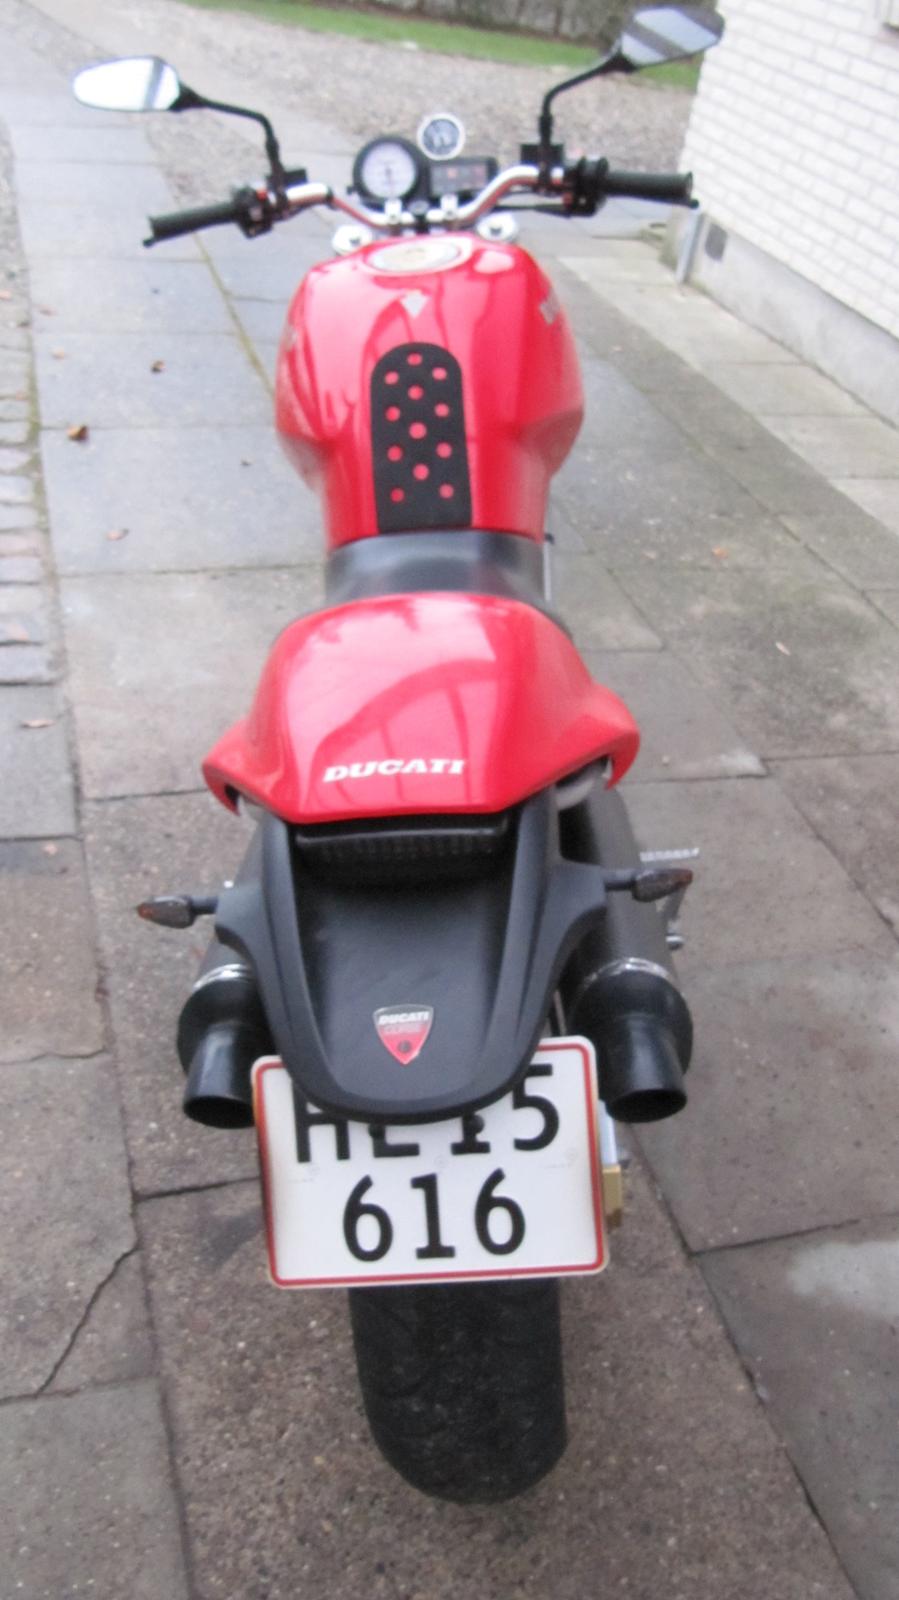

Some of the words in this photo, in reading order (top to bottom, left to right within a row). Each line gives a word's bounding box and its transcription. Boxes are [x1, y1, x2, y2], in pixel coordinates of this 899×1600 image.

[323, 758, 465, 783] DUCATI
[378, 1011, 430, 1025] DUCATI
[343, 1168, 525, 1262] 616
